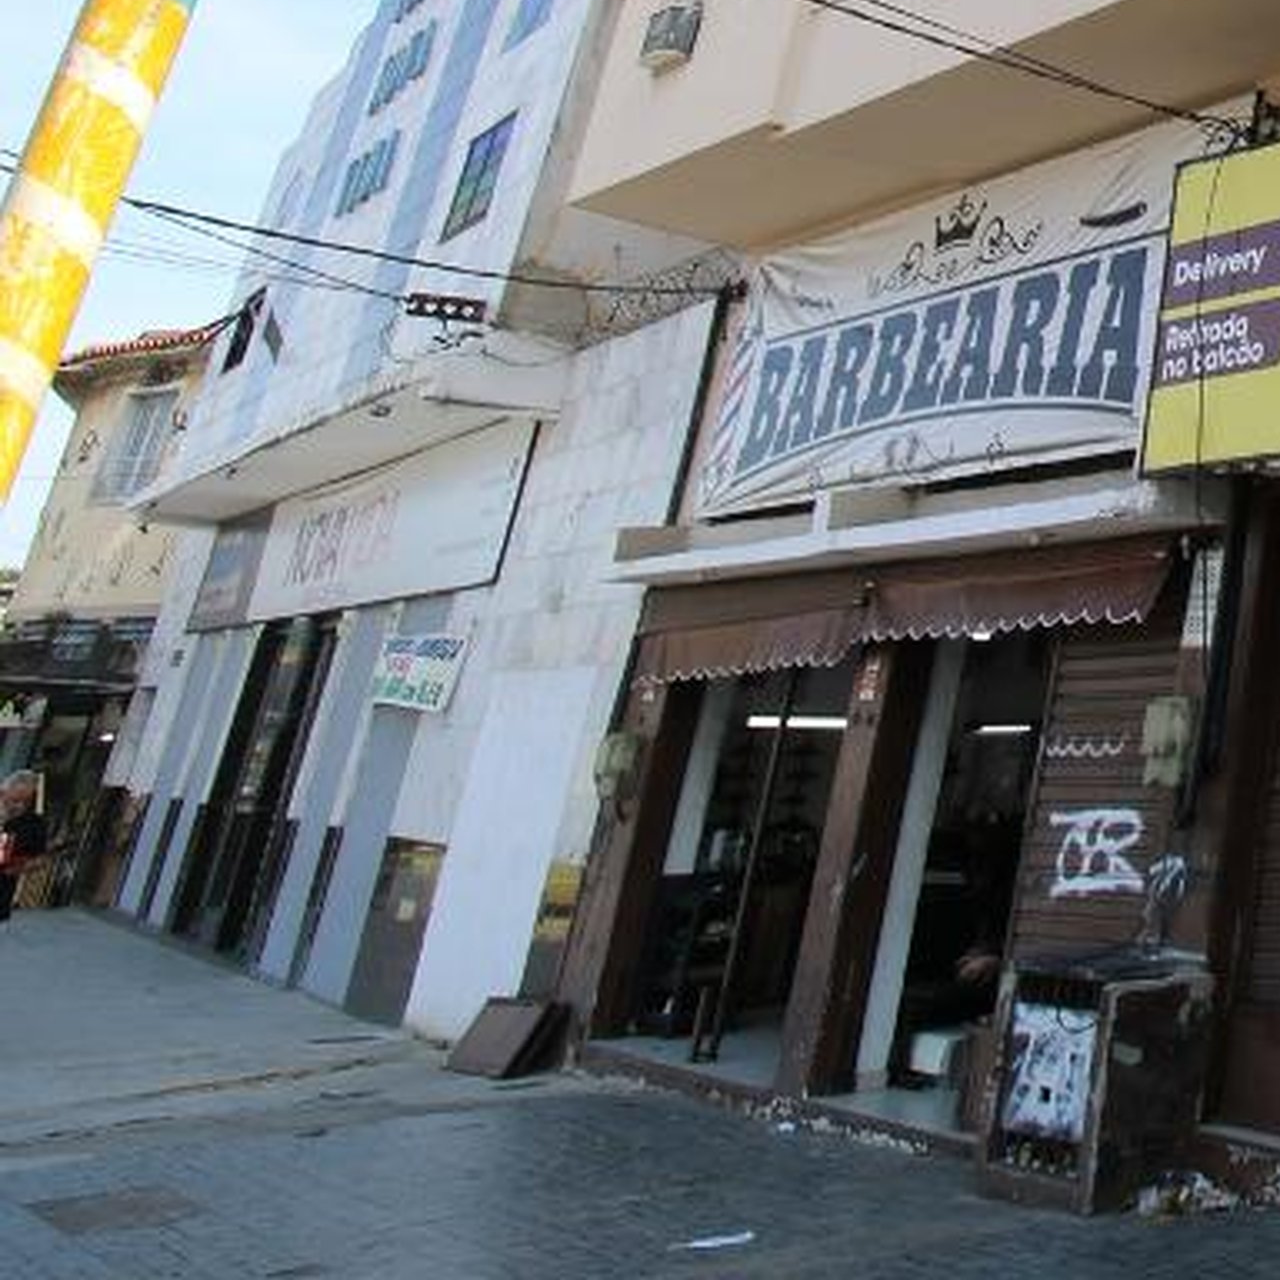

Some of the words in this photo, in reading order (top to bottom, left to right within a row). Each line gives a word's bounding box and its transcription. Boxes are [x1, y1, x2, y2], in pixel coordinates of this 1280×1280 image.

[1172, 244, 1269, 287] Delivery
[1165, 314, 1249, 352] Retirada
[734, 244, 1149, 480] BARBEARIA
[1161, 356, 1188, 381] no
